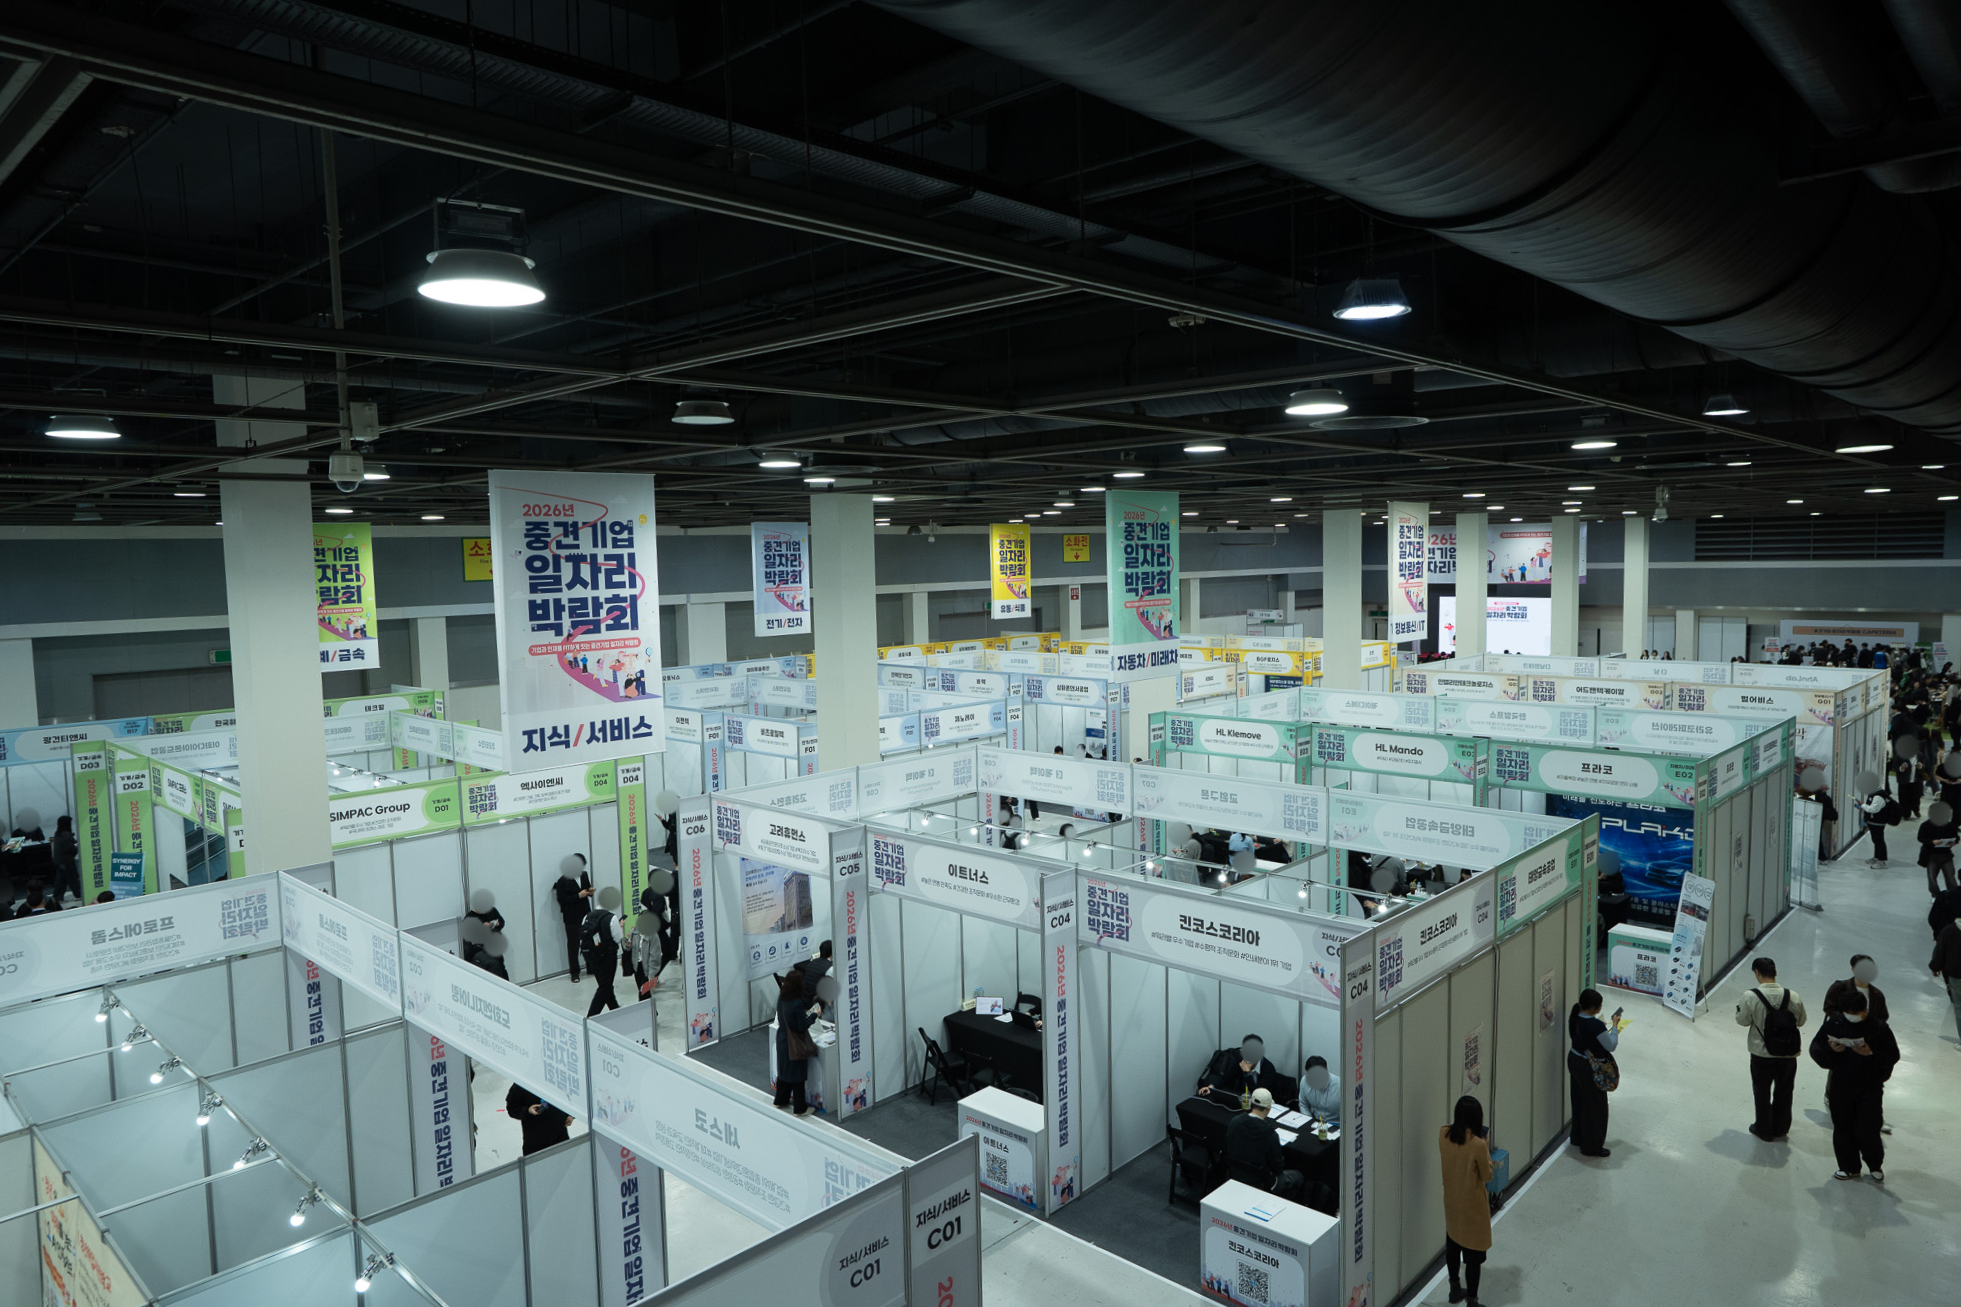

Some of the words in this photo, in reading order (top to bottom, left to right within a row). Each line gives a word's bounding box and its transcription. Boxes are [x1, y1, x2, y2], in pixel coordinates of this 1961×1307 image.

[522, 503, 574, 517] 2026년
[1124, 511, 1146, 520] 2026년
[524, 520, 634, 552] 중견기업
[1124, 522, 1170, 542] 중견기업
[1399, 524, 1424, 540] 중견기업
[764, 540, 800, 552] 중견기업
[1066, 536, 1088, 547] 소화전
[1124, 543, 1170, 569] 일자리
[1399, 541, 1424, 560] 일자리
[764, 554, 801, 568] 일자리
[525, 552, 637, 594] 일자리
[765, 570, 802, 585] 박람회
[1399, 561, 1424, 580] 박람회
[1124, 570, 1171, 597] 박람회
[528, 593, 639, 636] 박람회
[1000, 604, 1026, 614] 유통/식품
[766, 618, 803, 630] 전기/전자
[1394, 620, 1425, 636] 정보통신/IT
[1117, 648, 1178, 672] 자동차/미래차
[1576, 686, 1624, 696] 어드밴텍케이알
[1740, 696, 1774, 705] 펄어비스
[522, 715, 653, 754] 지식/서비스
[708, 732, 720, 740] F01
[1216, 728, 1226, 736] HL
[1227, 730, 1262, 740] Klemove
[804, 746, 815, 754] F01
[1375, 743, 1388, 752] HL
[1389, 744, 1424, 756] Mando
[80, 762, 100, 770] D03
[1581, 762, 1614, 775] 프라코
[1674, 770, 1694, 779] E02
[122, 782, 144, 790] D02
[520, 776, 564, 791] 엑사이엔씨
[594, 779, 608, 787] D04
[622, 775, 640, 784] D04
[330, 807, 373, 822] SIMPAC
[374, 802, 410, 816] Group
[434, 804, 449, 812] D01
[682, 814, 708, 824] 지식/서비스
[686, 825, 706, 836] C06
[769, 824, 806, 842] 고려휴먼스
[874, 840, 904, 856] 중견기업
[836, 852, 864, 864] 지식/서비스
[874, 851, 905, 872] 일자리
[1586, 852, 1594, 864] E01
[120, 864, 132, 872] FOR
[692, 848, 702, 887] 2026년
[839, 864, 860, 876] C05
[948, 863, 989, 885] 이트너스
[874, 866, 905, 887] 박람회
[1086, 886, 1130, 906] 중견기업
[846, 890, 856, 936] 2026년
[1046, 900, 1074, 914] 지식/서비스
[1086, 900, 1130, 926] 일자리
[1050, 912, 1071, 928] C04
[1477, 912, 1488, 924] C04
[1087, 918, 1130, 942] 박람회
[1179, 914, 1260, 946] 킨코스코리아
[1420, 912, 1458, 946] 킨코스코리아
[1151, 932, 1172, 943] #워라밸
[1172, 934, 1183, 945] 우수
[1184, 938, 1194, 948] 기업
[1194, 942, 1216, 954] #수평적
[1216, 946, 1240, 959] 조직문화
[1240, 952, 1270, 967] #인쇄분야
[1270, 958, 1280, 968] 1위
[1280, 960, 1292, 970] 기업
[1636, 954, 1657, 962] 프라코
[1056, 944, 1066, 998] 2026년
[1346, 964, 1372, 982] 지식/서비스
[1350, 981, 1368, 1000] C04
[306, 980, 325, 1038] 중견기업
[1355, 1018, 1363, 1083] 2026년
[430, 1060, 451, 1127] 중견기업
[1059, 1102, 1069, 1148] 박람회
[982, 1136, 1010, 1153] 이트너스
[916, 1188, 972, 1228] 지식/서비스
[620, 1176, 644, 1259] 중견기업
[926, 1222, 962, 1250] C01
[838, 1236, 890, 1271] 지식/서비스
[1228, 1240, 1280, 1269] 킨코스코리아
[850, 1260, 881, 1288] C01
